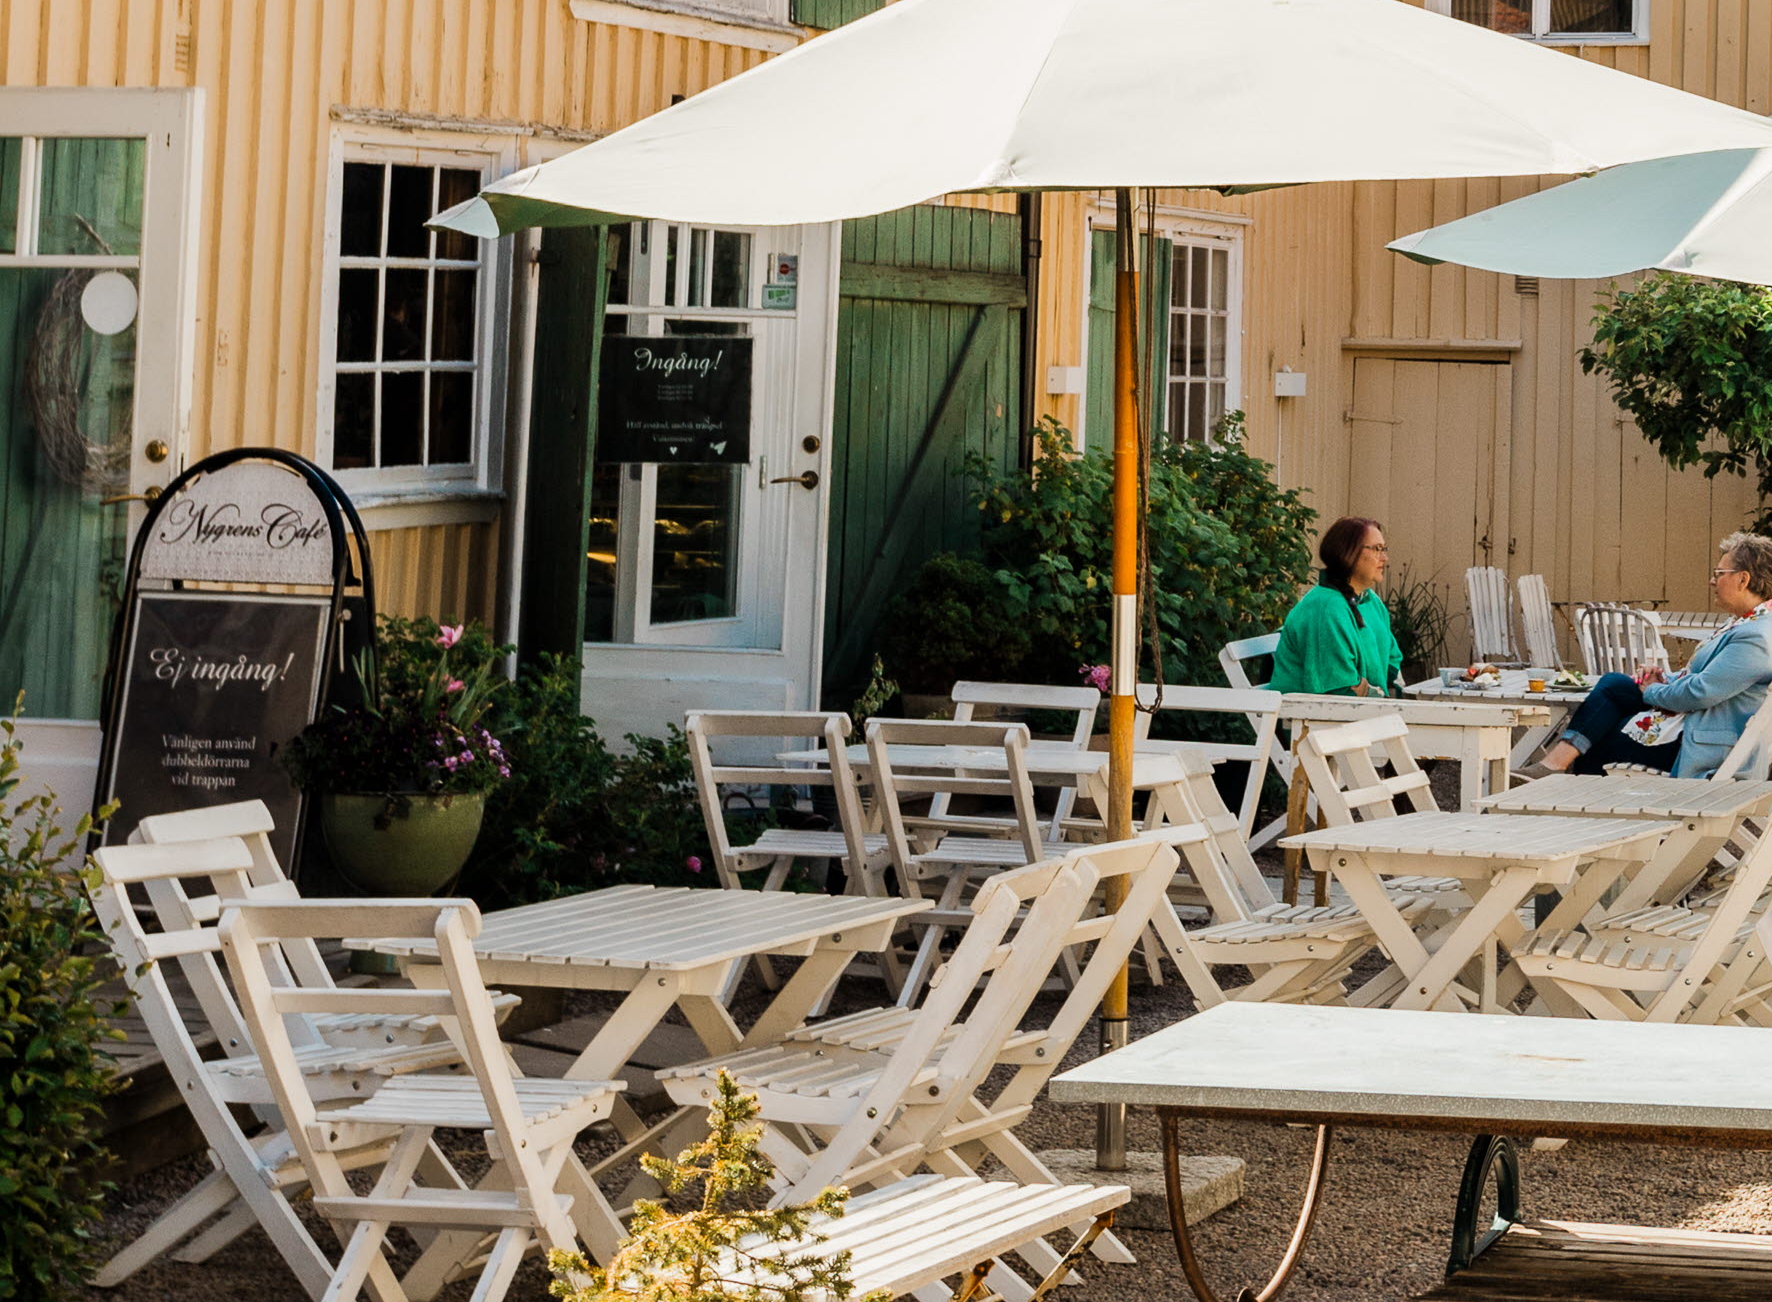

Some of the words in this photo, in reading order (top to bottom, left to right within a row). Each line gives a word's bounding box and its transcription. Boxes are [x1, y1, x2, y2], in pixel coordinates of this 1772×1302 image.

[634, 347, 723, 378] Ingång!
[160, 499, 263, 545] Nygrens
[261, 503, 327, 549] Café
[150, 648, 187, 689] Ej
[191, 652, 295, 692] ingång!
[162, 734, 213, 752] Vänligen
[215, 736, 257, 750] använd
[161, 754, 250, 769] dubbeldörrarna
[171, 772, 189, 786] vid
[191, 775, 236, 791] trappan
